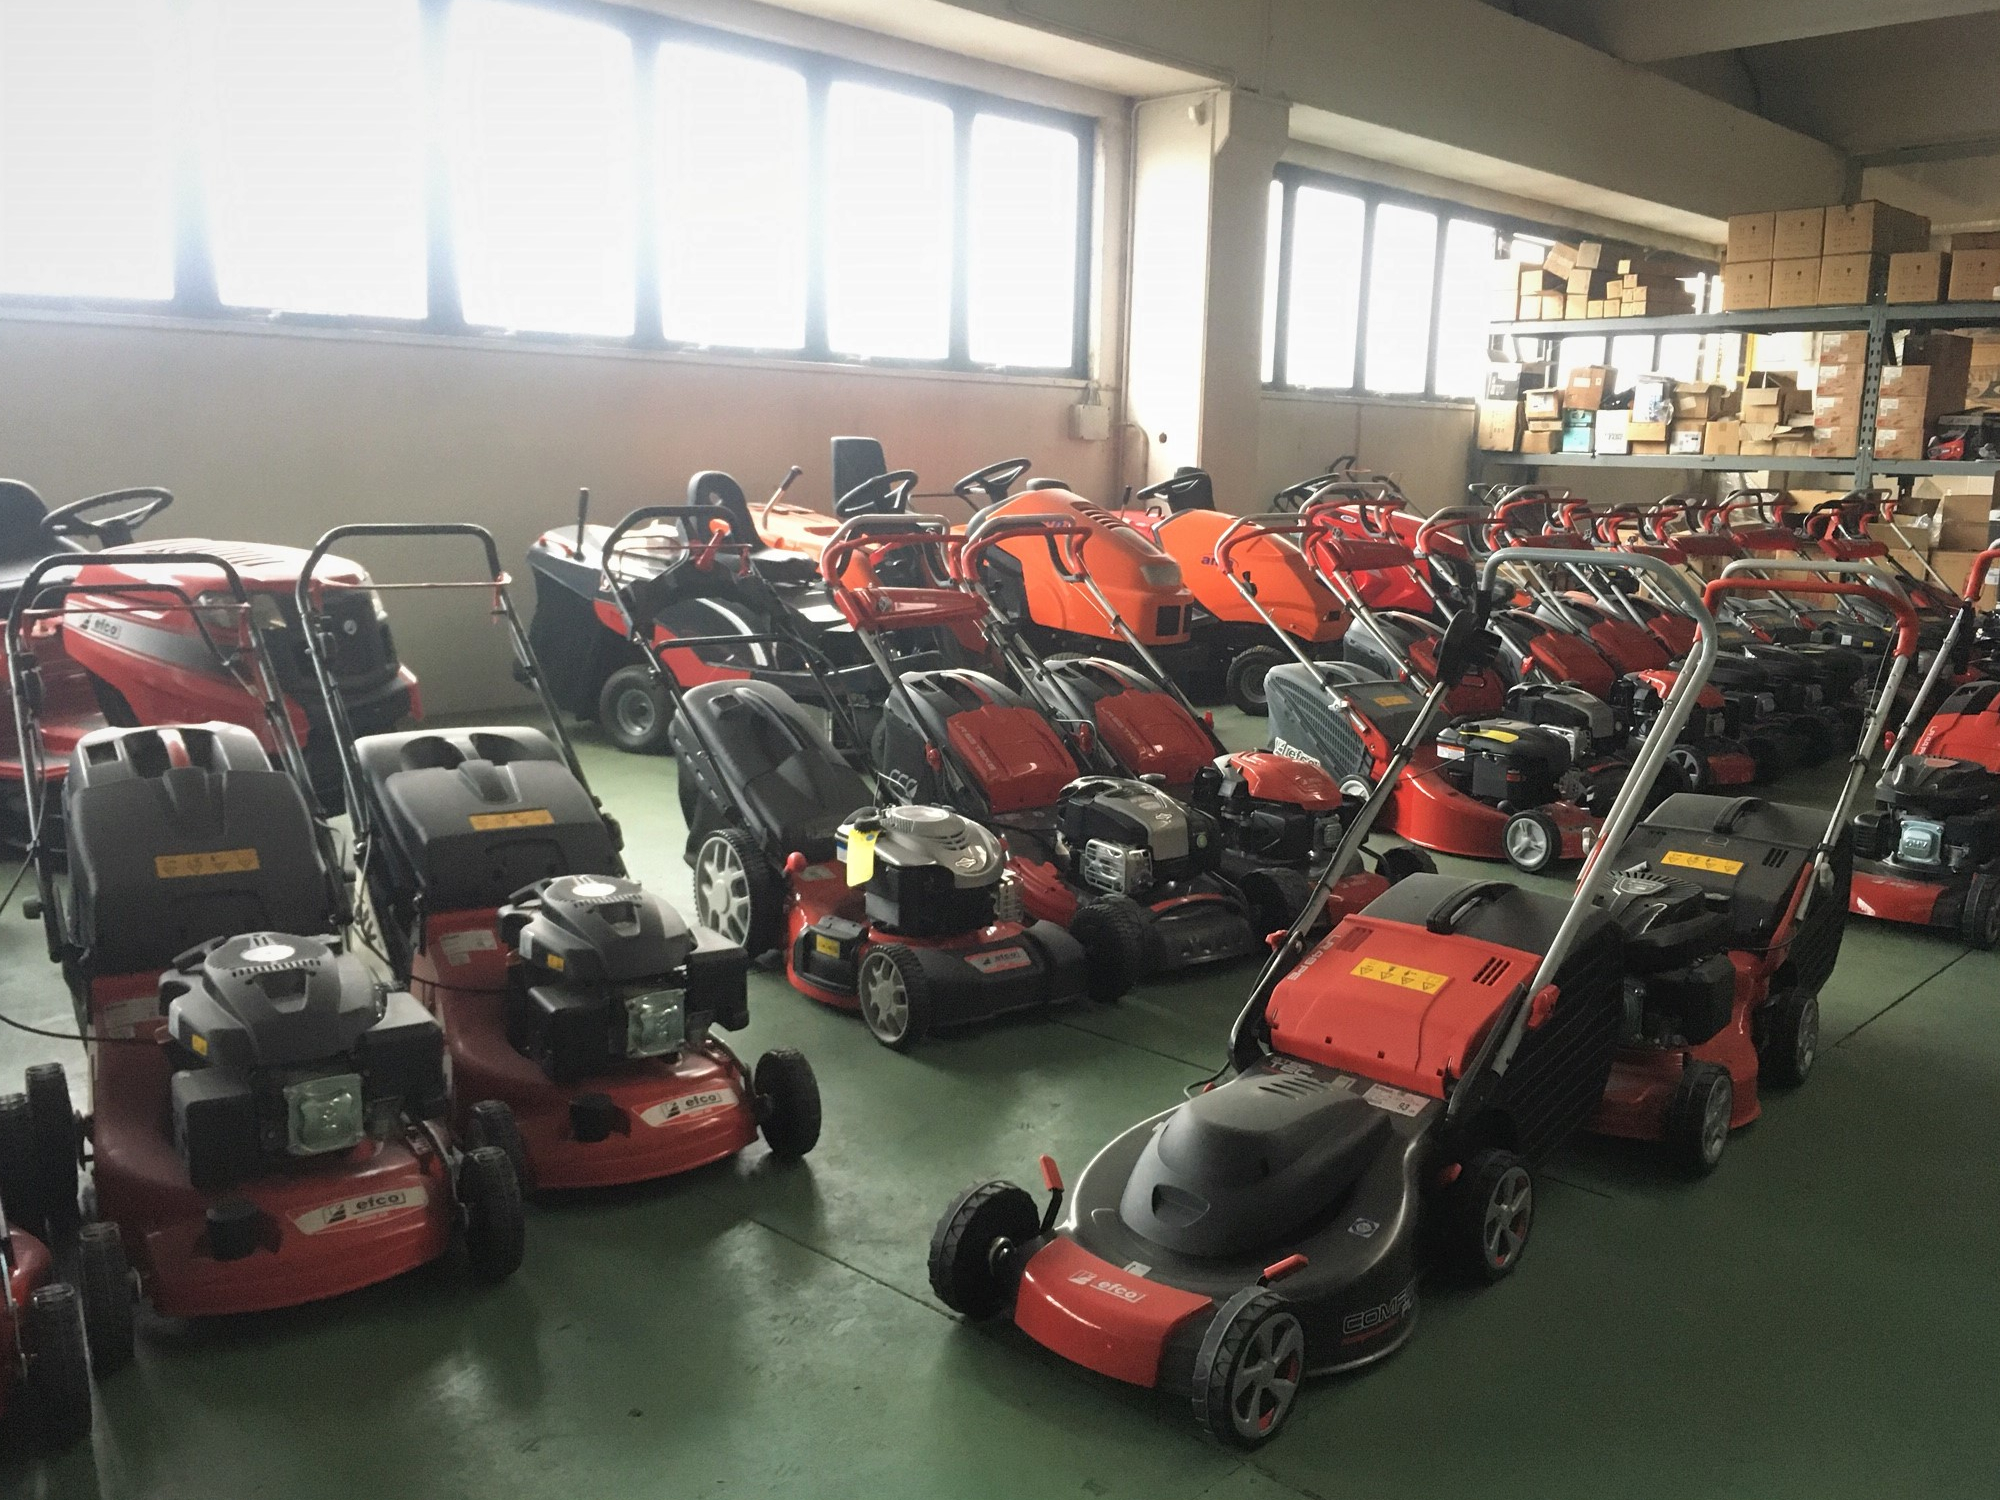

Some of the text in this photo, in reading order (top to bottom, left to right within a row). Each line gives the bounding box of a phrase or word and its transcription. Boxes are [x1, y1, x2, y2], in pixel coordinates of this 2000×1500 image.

[94, 619, 118, 635] efco
[685, 1095, 717, 1107] efco
[356, 1194, 399, 1210] efco
[1097, 1281, 1138, 1299] efco
